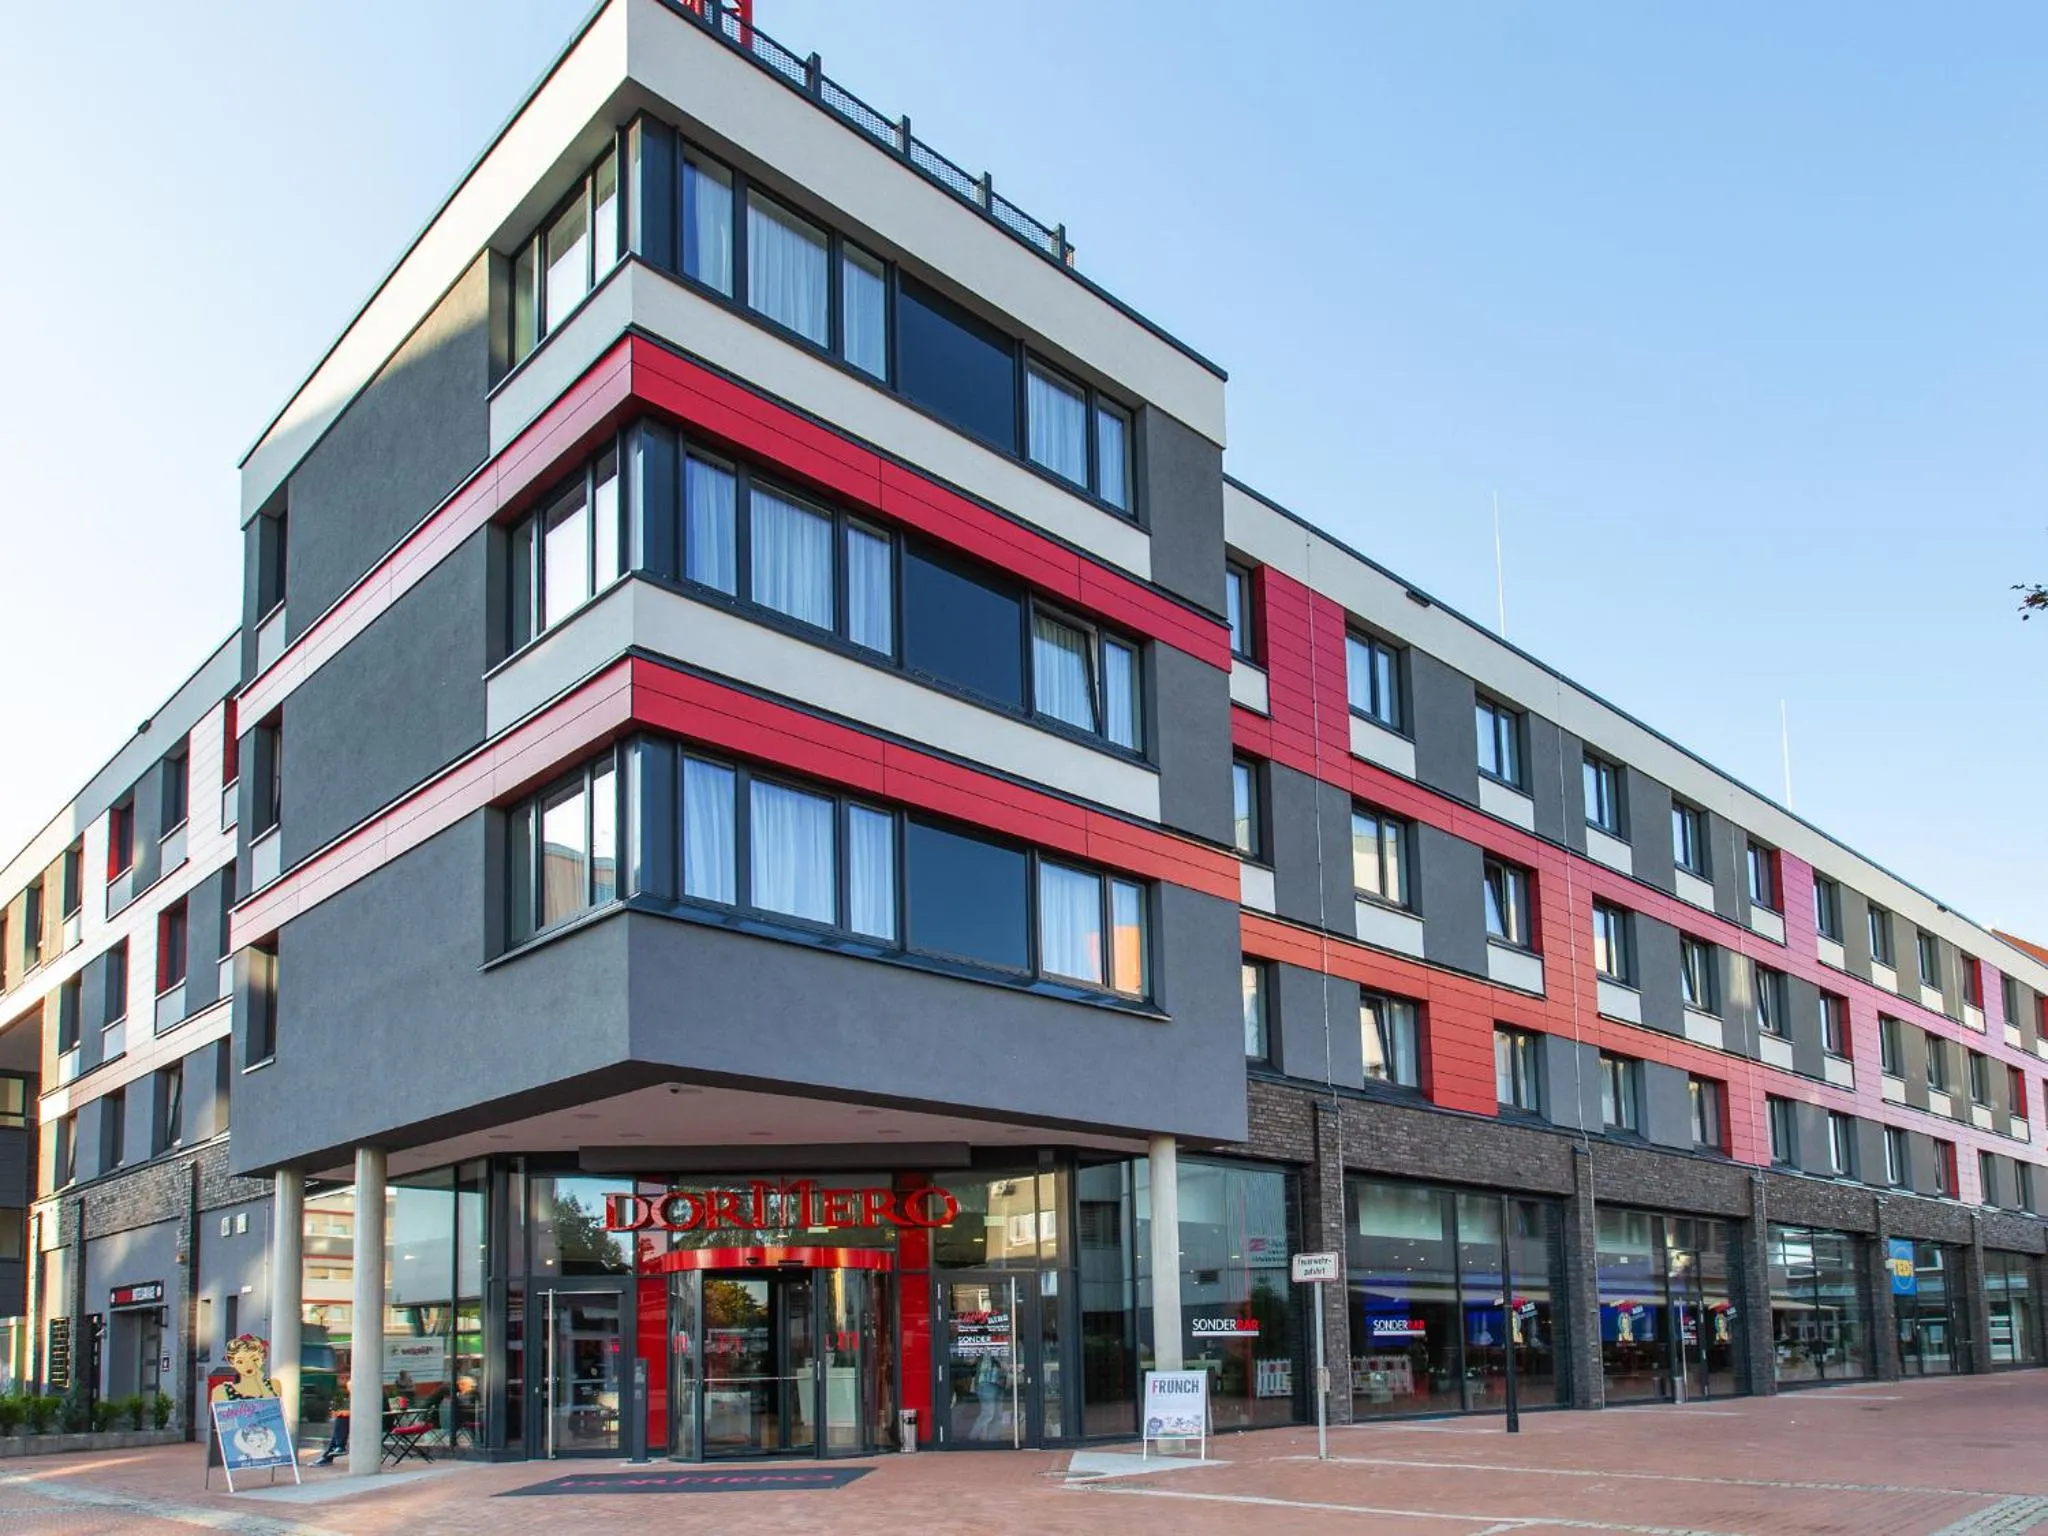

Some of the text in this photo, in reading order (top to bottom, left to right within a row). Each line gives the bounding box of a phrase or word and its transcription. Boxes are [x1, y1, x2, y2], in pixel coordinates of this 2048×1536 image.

[603, 1178, 958, 1231] DORMERO
[1193, 1318, 1259, 1331] SONDERBAR
[1151, 1379, 1200, 1394] FRUNCH
